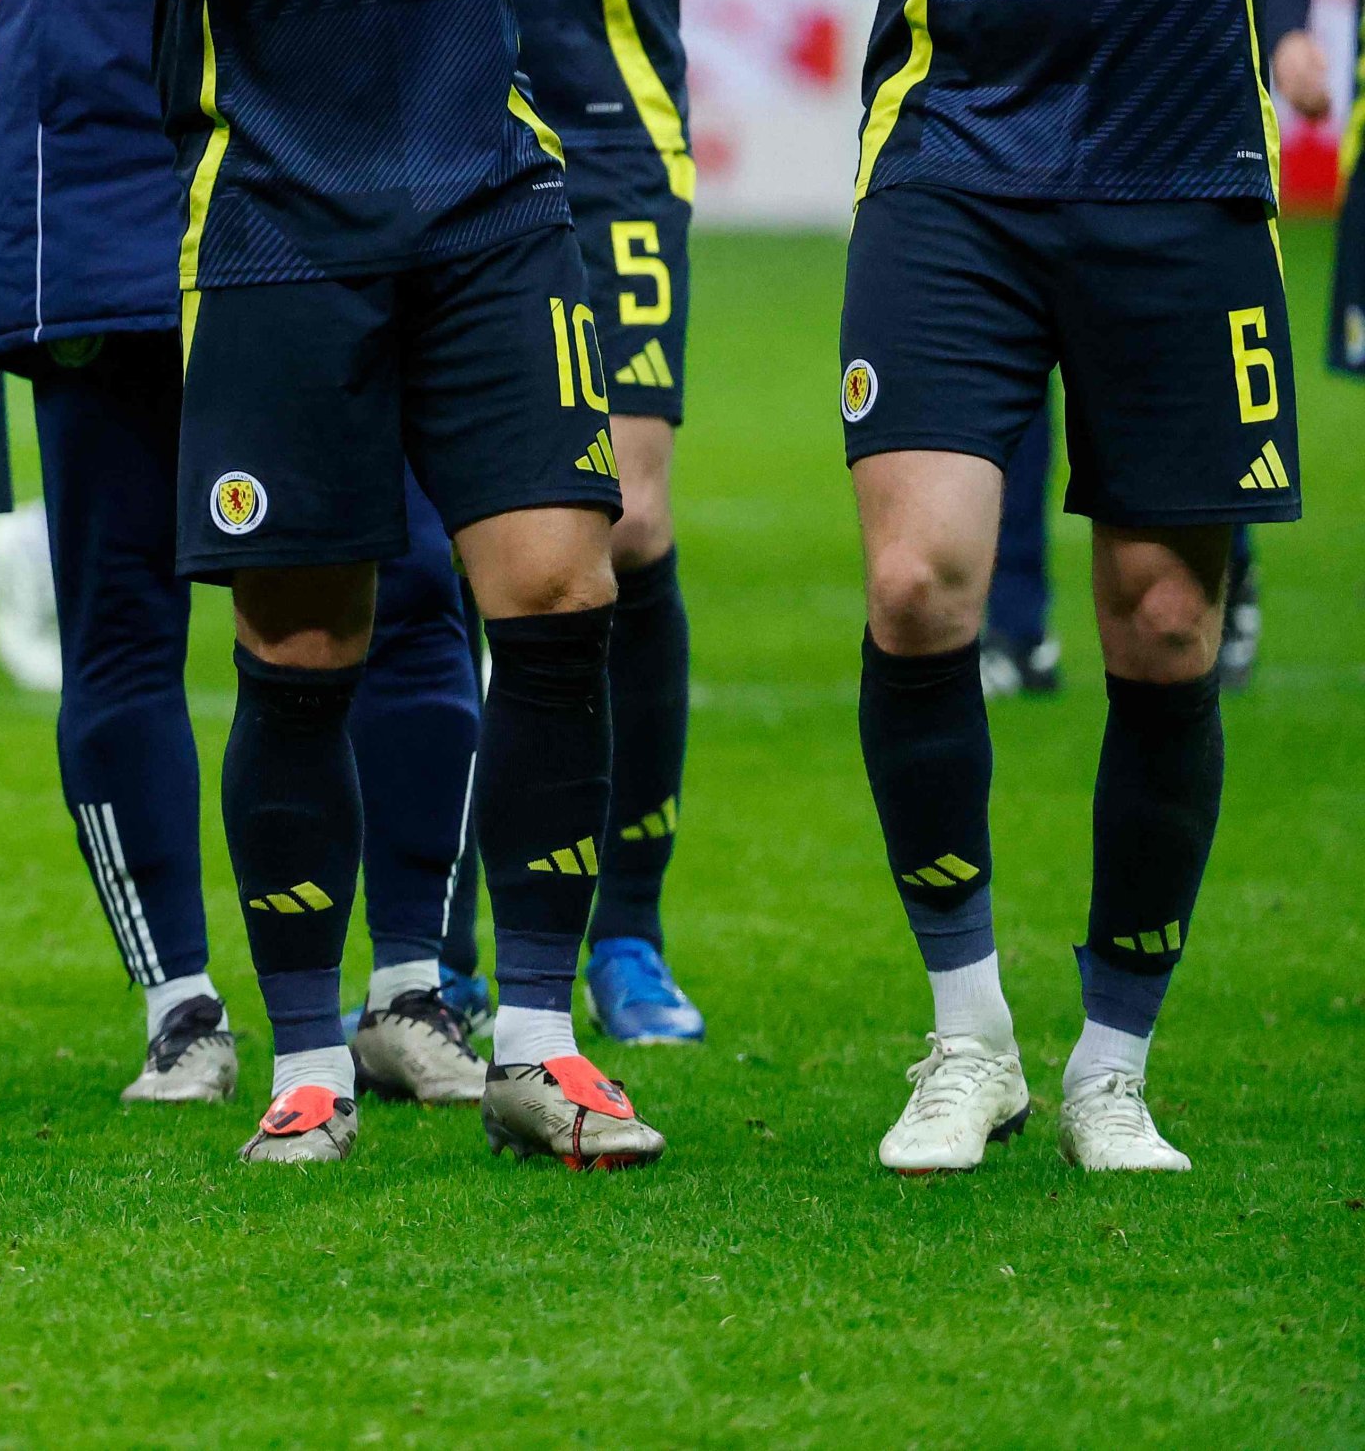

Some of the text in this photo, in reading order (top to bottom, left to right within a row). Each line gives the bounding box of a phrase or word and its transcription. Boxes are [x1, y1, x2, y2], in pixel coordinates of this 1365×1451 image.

[611, 221, 672, 326] 5
[550, 298, 610, 413] 10
[1228, 307, 1279, 424] 6
